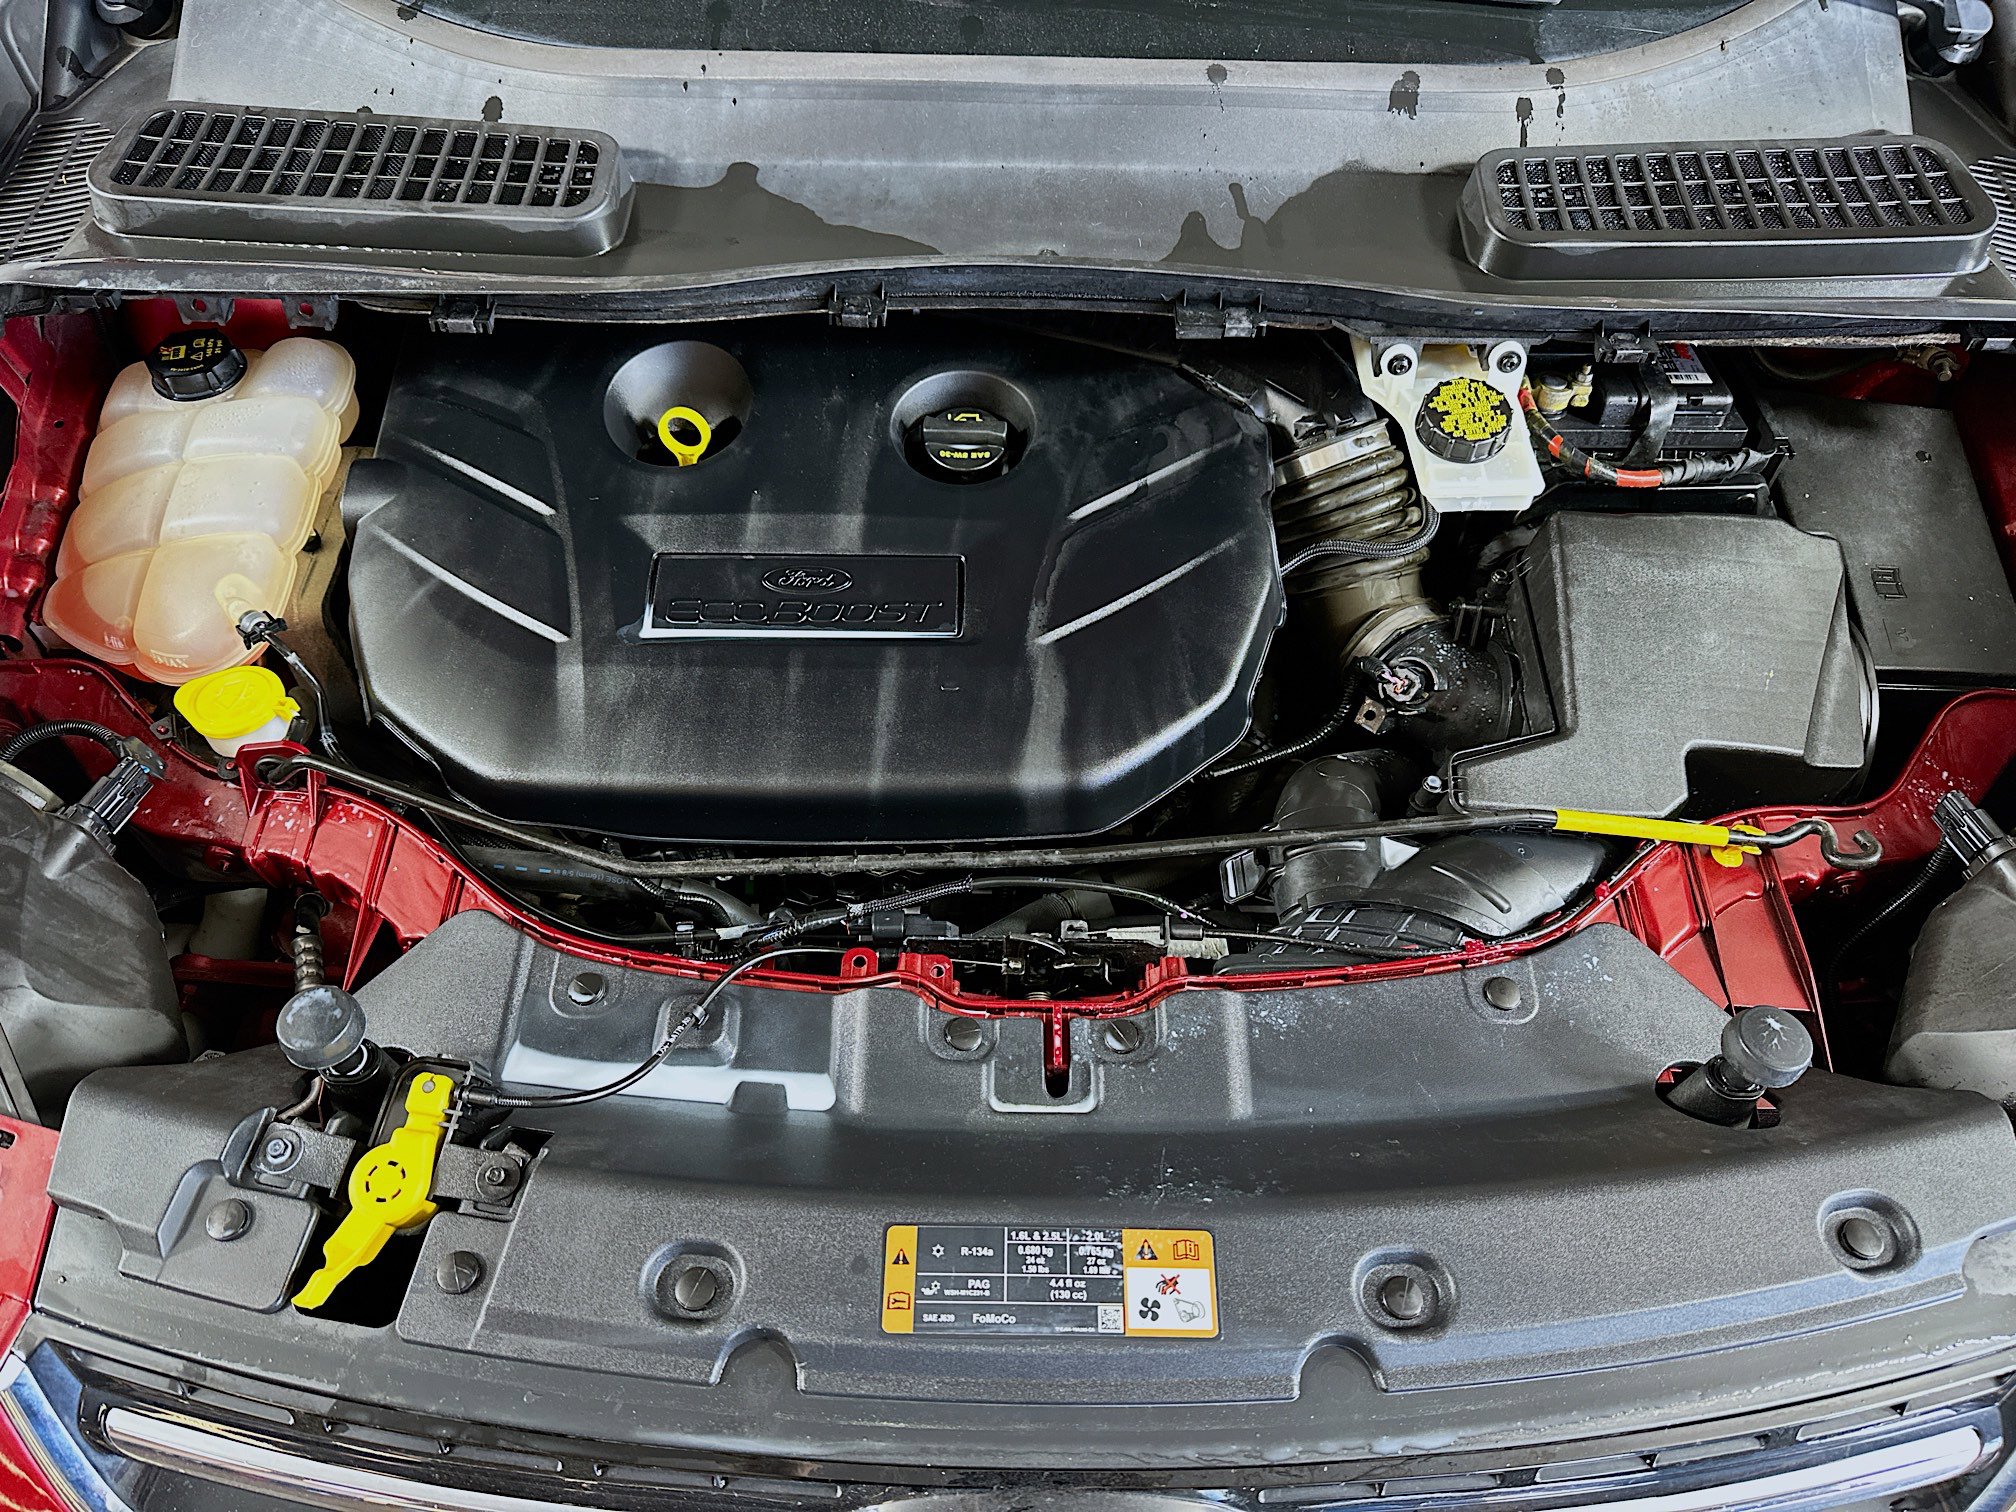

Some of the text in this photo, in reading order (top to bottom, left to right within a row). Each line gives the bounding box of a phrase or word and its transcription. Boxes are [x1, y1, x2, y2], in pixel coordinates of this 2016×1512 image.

[778, 570, 835, 587] Ford
[576, 870, 604, 881] (16mm)
[1010, 1230, 1063, 1241] 1.6L & 2.5L
[1086, 1231, 1106, 1242] 2.0L
[960, 1246, 994, 1257] R-134a
[1041, 1245, 1054, 1257] kg
[1025, 1256, 1036, 1265] 24
[1086, 1256, 1107, 1266] 27 oz
[967, 1279, 991, 1290] PAG
[1049, 1278, 1064, 1288] 4.4
[1073, 1280, 1086, 1289] oz
[1050, 1289, 1088, 1302] (130 cc)
[922, 1313, 938, 1323] SAE
[972, 1313, 1017, 1324] FoMoCo
